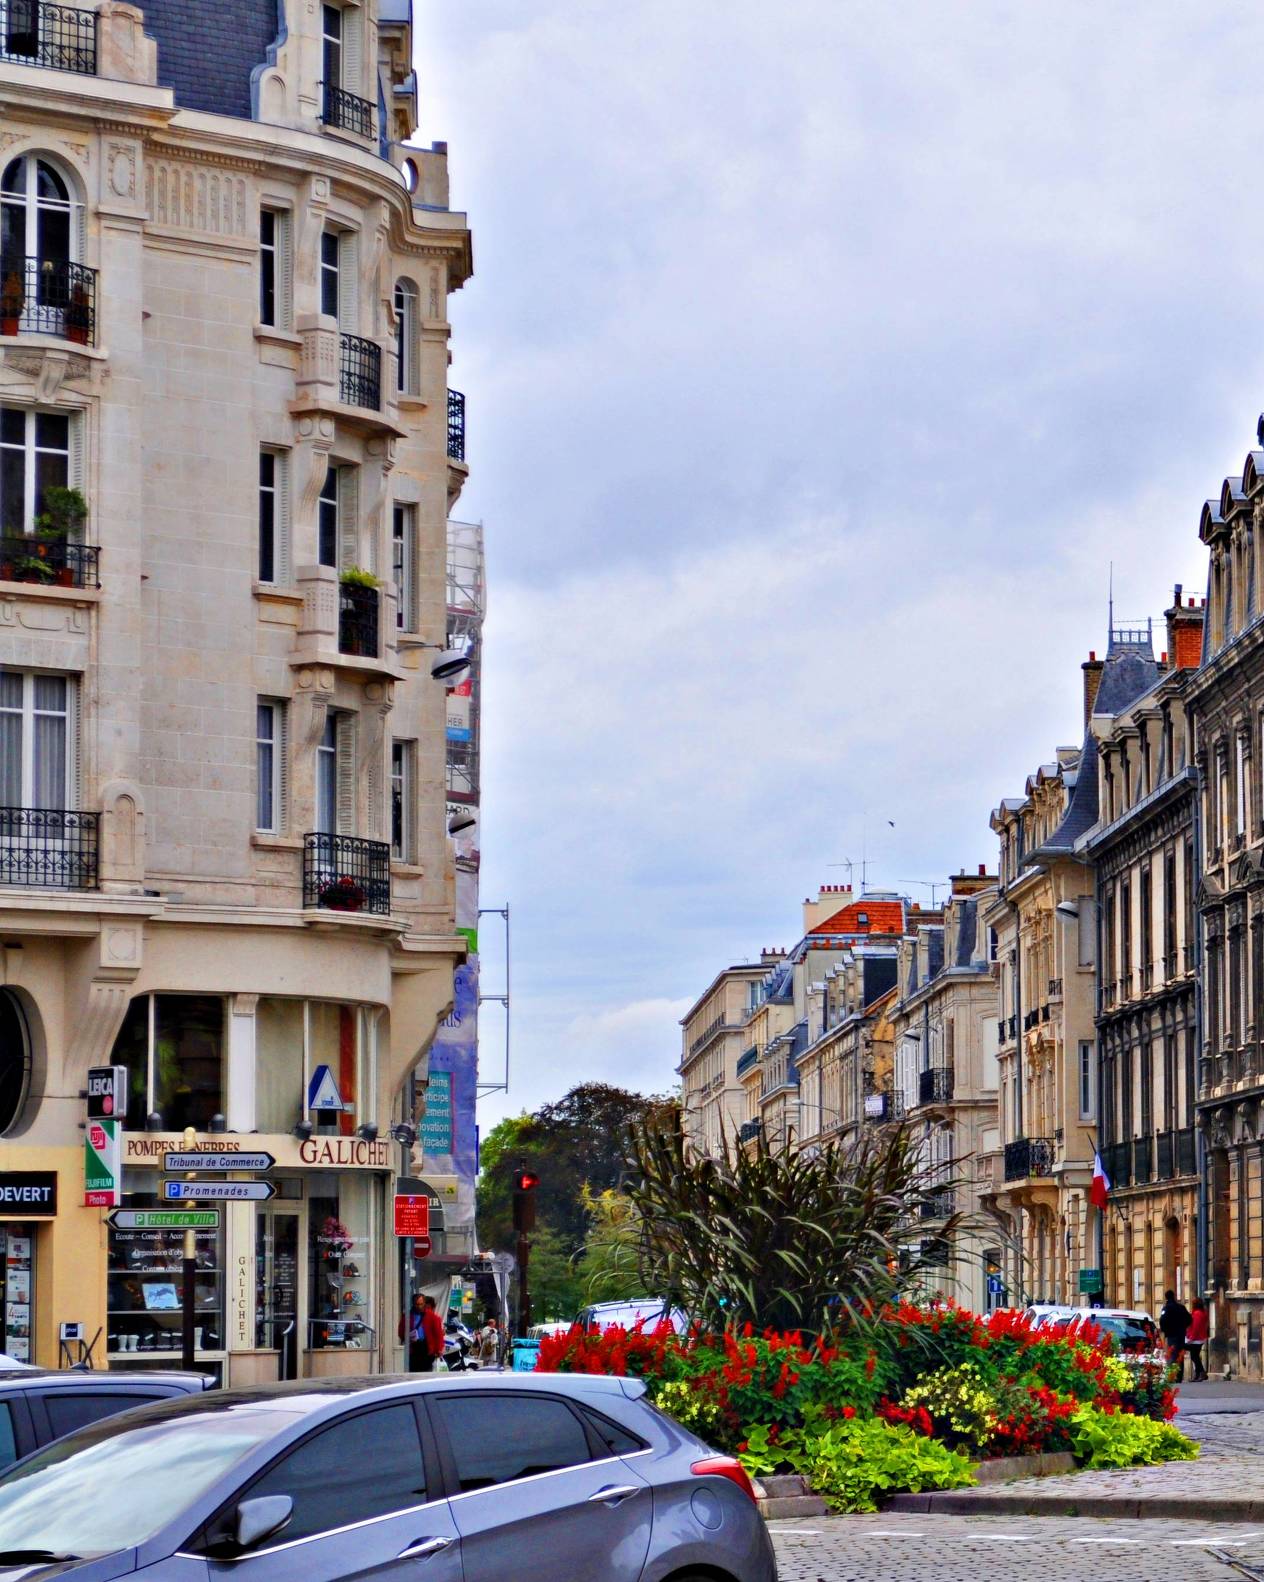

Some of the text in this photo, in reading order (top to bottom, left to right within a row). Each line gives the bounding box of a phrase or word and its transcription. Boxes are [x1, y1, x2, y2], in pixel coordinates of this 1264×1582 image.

[88, 1078, 113, 1096] LEICA
[127, 1140, 240, 1156] POMPES FNEBRES
[299, 1138, 389, 1166] GALICHET
[169, 1157, 265, 1168] Tribunal de Commerce
[86, 1178, 113, 1188] FUJIFILM
[183, 1186, 249, 1197] Promenades
[89, 1194, 107, 1205] Photo
[149, 1213, 174, 1225] Hôtel
[178, 1214, 190, 1225] de
[193, 1213, 215, 1225] Ville
[238, 1256, 246, 1341] GALICHET
